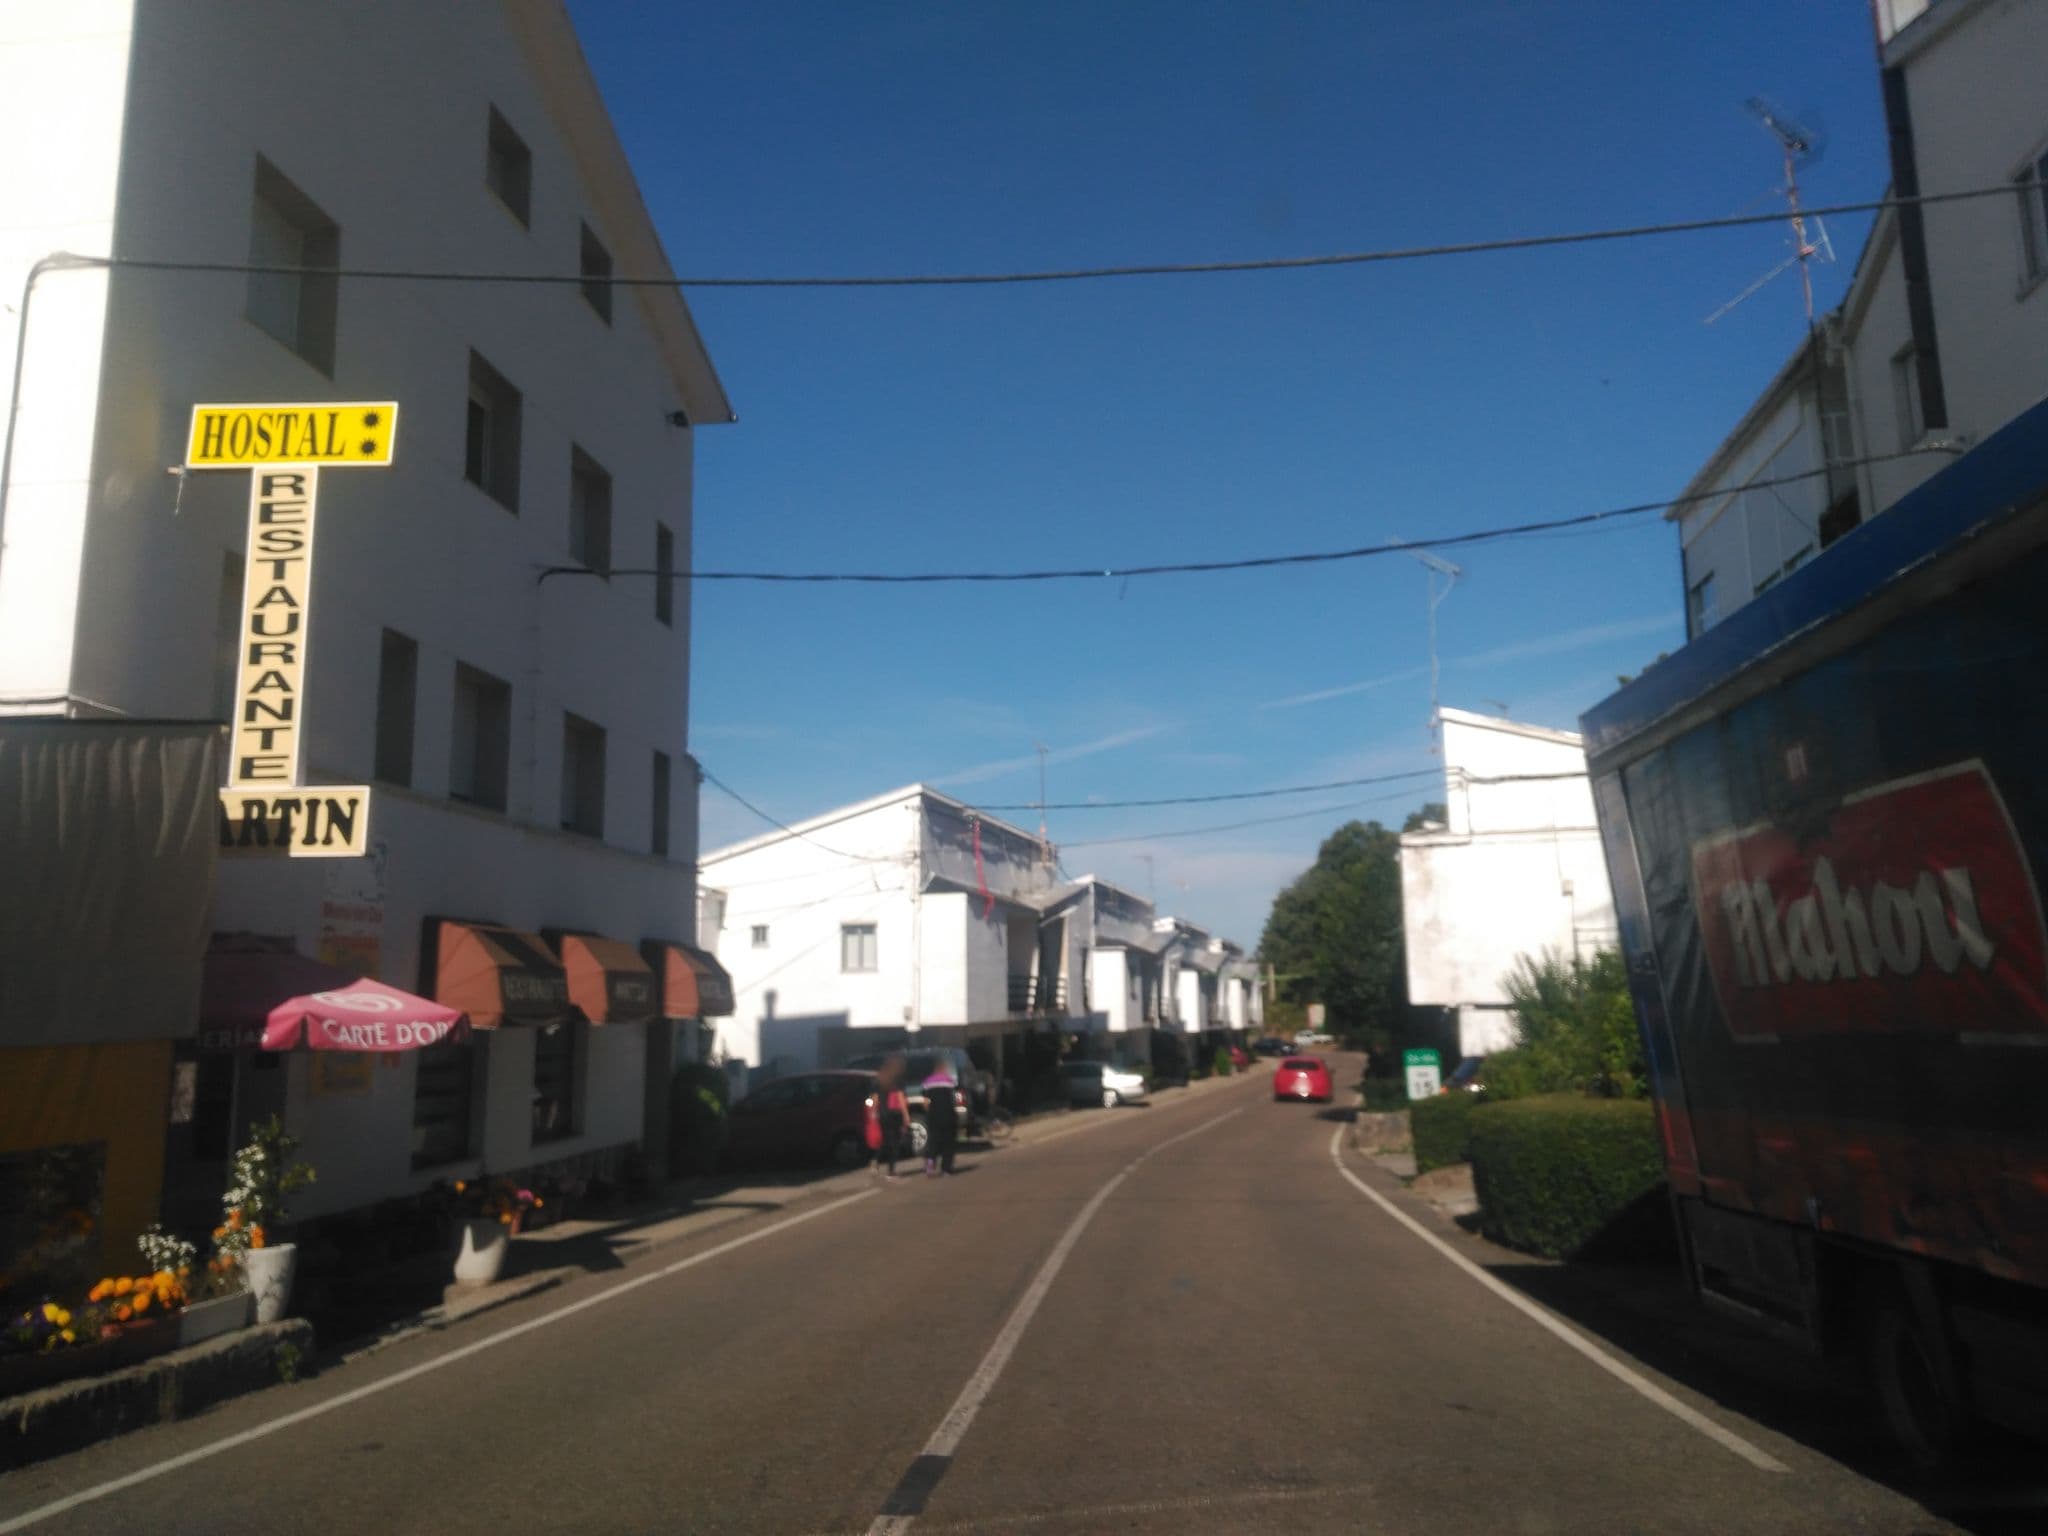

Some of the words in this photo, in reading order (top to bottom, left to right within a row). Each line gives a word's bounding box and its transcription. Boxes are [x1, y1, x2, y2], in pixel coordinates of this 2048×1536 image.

[200, 411, 346, 460] HOSTAL
[239, 473, 307, 781] RESTAURANTE
[1719, 856, 1995, 986] Mahou
[322, 1019, 389, 1049] CARTE
